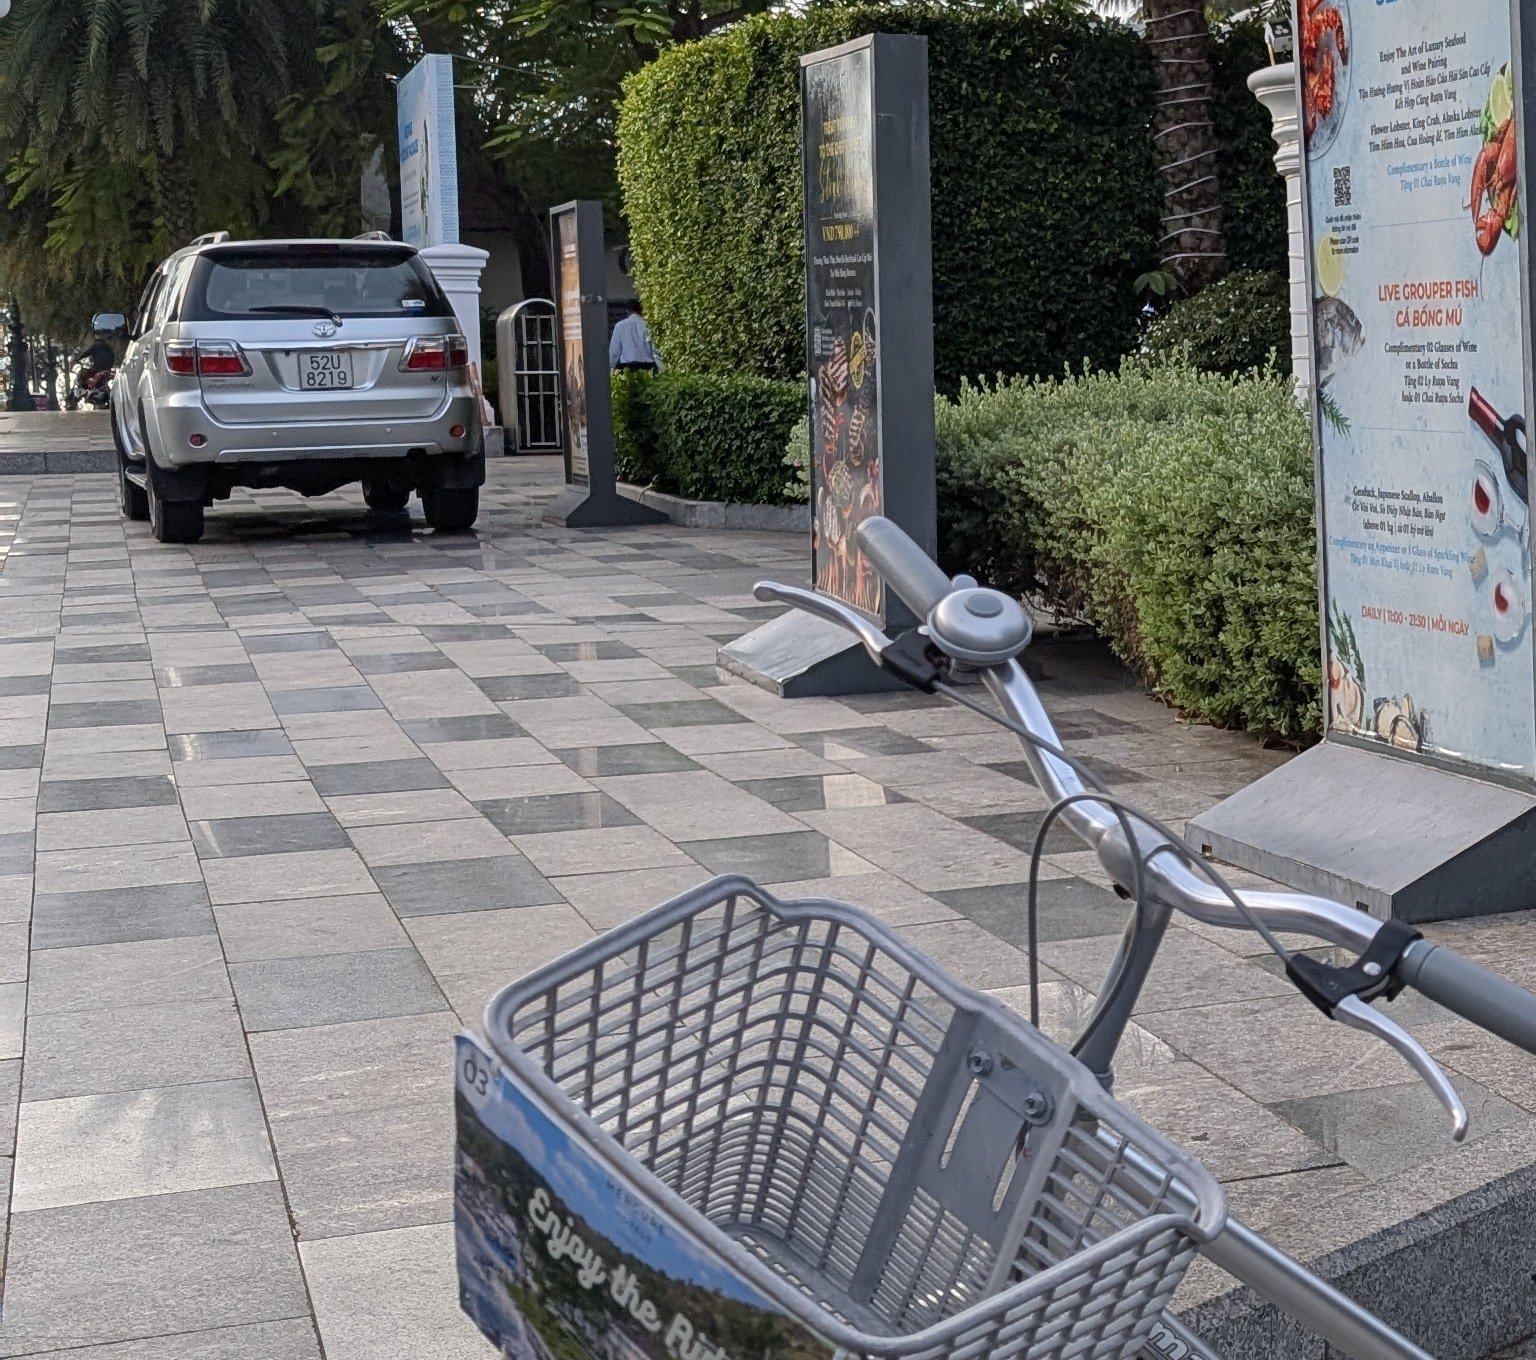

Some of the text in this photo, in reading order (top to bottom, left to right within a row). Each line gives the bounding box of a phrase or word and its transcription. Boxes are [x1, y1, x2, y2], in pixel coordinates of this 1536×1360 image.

[1380, 32, 1466, 63] Enjoy The Art of Luxury Seafood
[1401, 56, 1447, 75] and Wine Pairing
[1370, 122, 1388, 136] Flower
[1412, 117, 1425, 130] King
[1378, 279, 1479, 302] LIVE GROUPER FISH
[1395, 306, 1410, 327] CÁ
[1445, 302, 1463, 326] MÚ
[1384, 341, 1426, 356] Complimentary
[1434, 341, 1454, 353] Glasses
[1455, 341, 1462, 353] of
[1463, 340, 1477, 353] Wine
[310, 355, 341, 370] 52U
[1405, 361, 1411, 370] or
[1417, 358, 1433, 370] Bottle
[1435, 358, 1441, 370] of
[306, 371, 348, 387] 8219
[1378, 488, 1400, 501] Japanese
[1361, 605, 1382, 620] DAILY
[1387, 609, 1403, 625] 11:00
[1409, 613, 1426, 629] 21:30
[464, 1059, 489, 1096] 03
[528, 1188, 606, 1290] Enjoy
[611, 1264, 662, 1332] the
